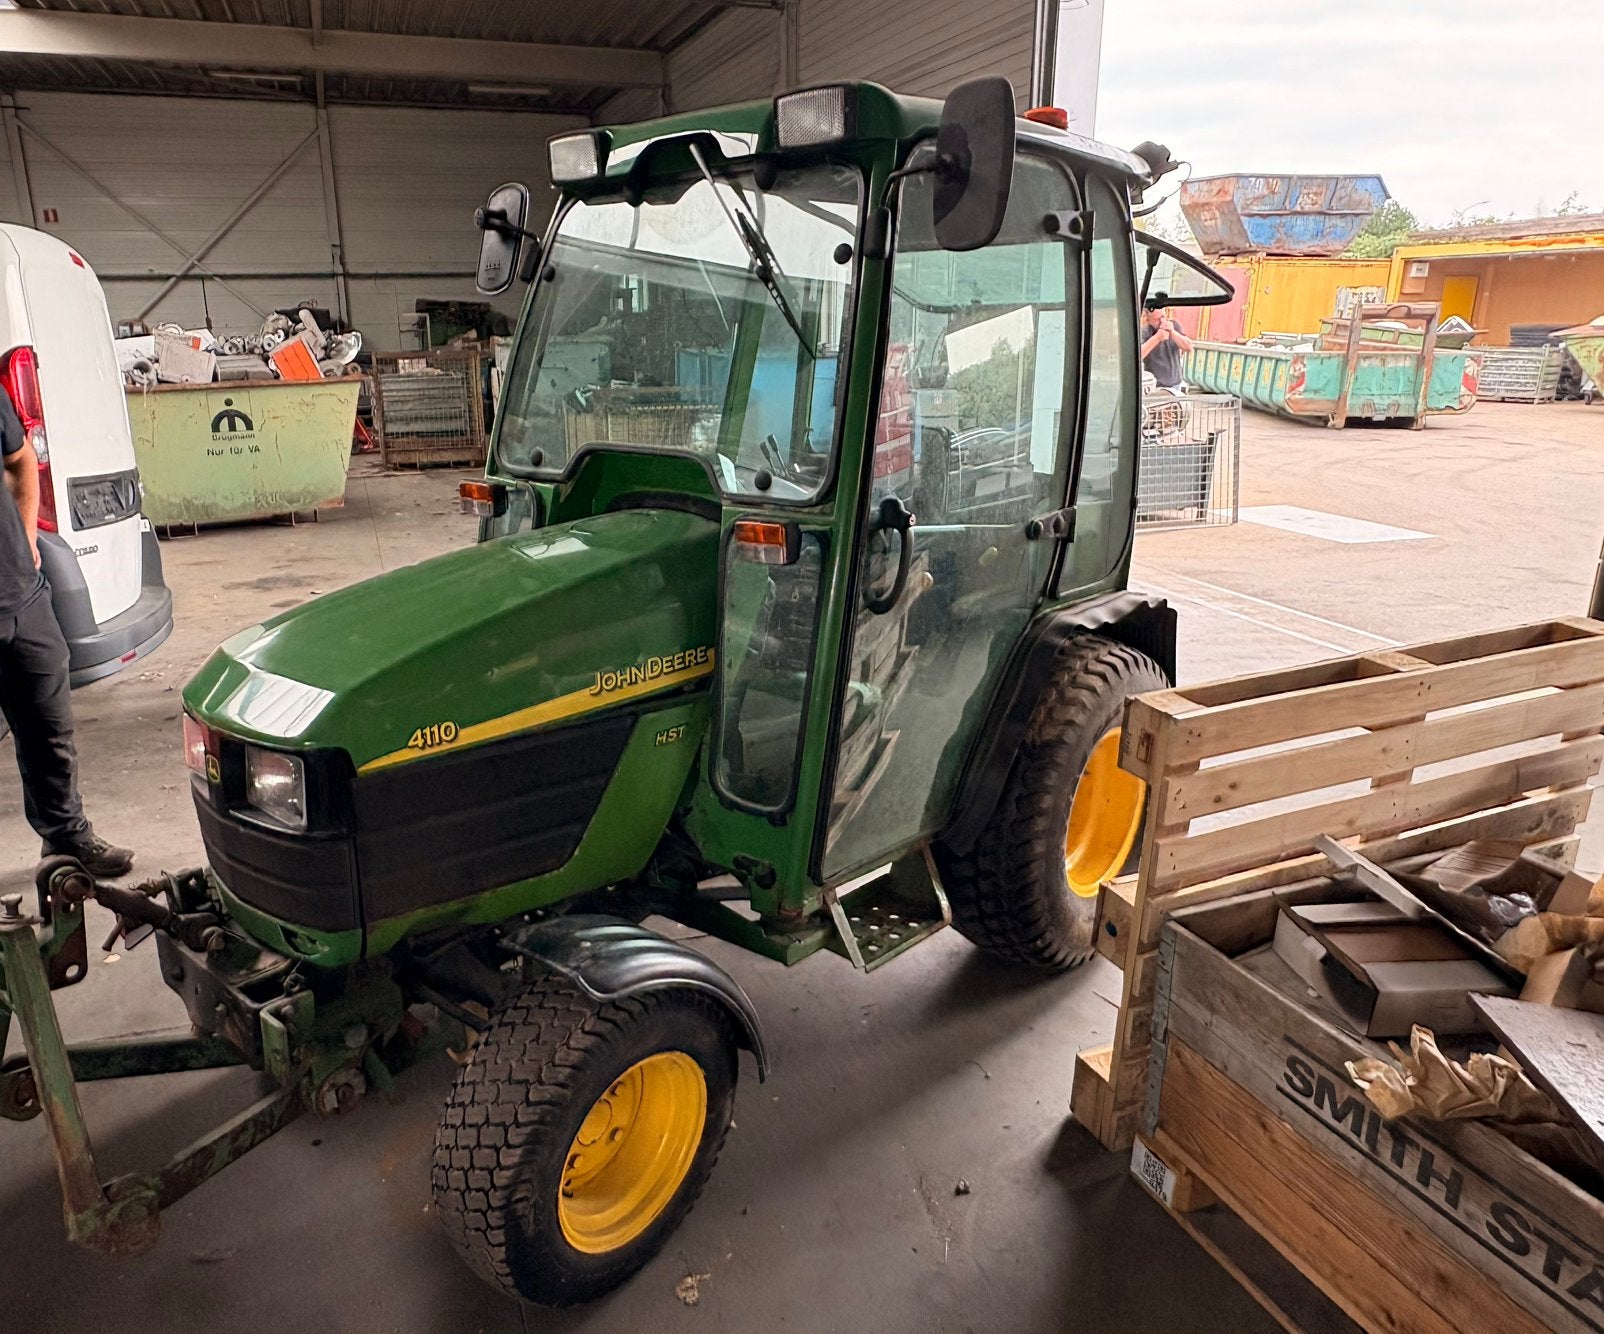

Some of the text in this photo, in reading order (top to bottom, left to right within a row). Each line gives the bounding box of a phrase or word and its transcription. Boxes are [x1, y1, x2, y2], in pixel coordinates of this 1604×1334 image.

[207, 448, 224, 456] Nur
[248, 444, 260, 454] VA
[590, 646, 707, 695] JOHN DEERE
[407, 721, 457, 749] 4110
[655, 725, 687, 746] HST
[1284, 1054, 1465, 1211] SMITH
